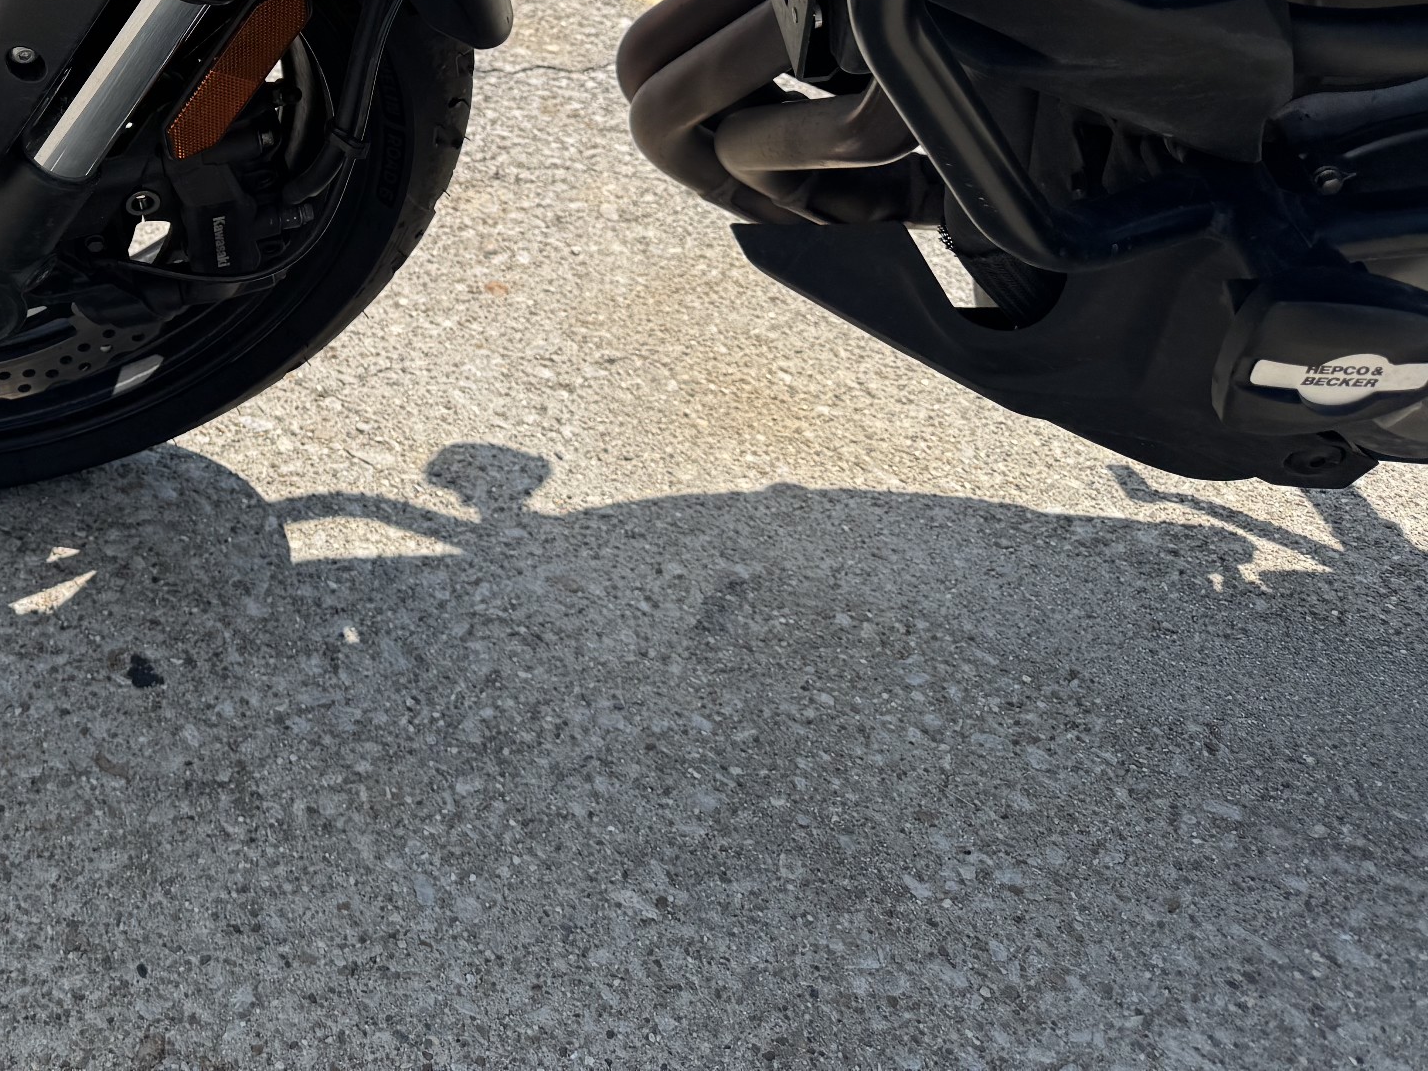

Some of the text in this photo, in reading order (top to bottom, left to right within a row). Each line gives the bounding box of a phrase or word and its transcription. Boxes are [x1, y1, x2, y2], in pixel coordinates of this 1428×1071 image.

[213, 216, 230, 268] Kawasaki
[1306, 366, 1384, 376] HEPCO &
[1300, 376, 1379, 387] BECKER
